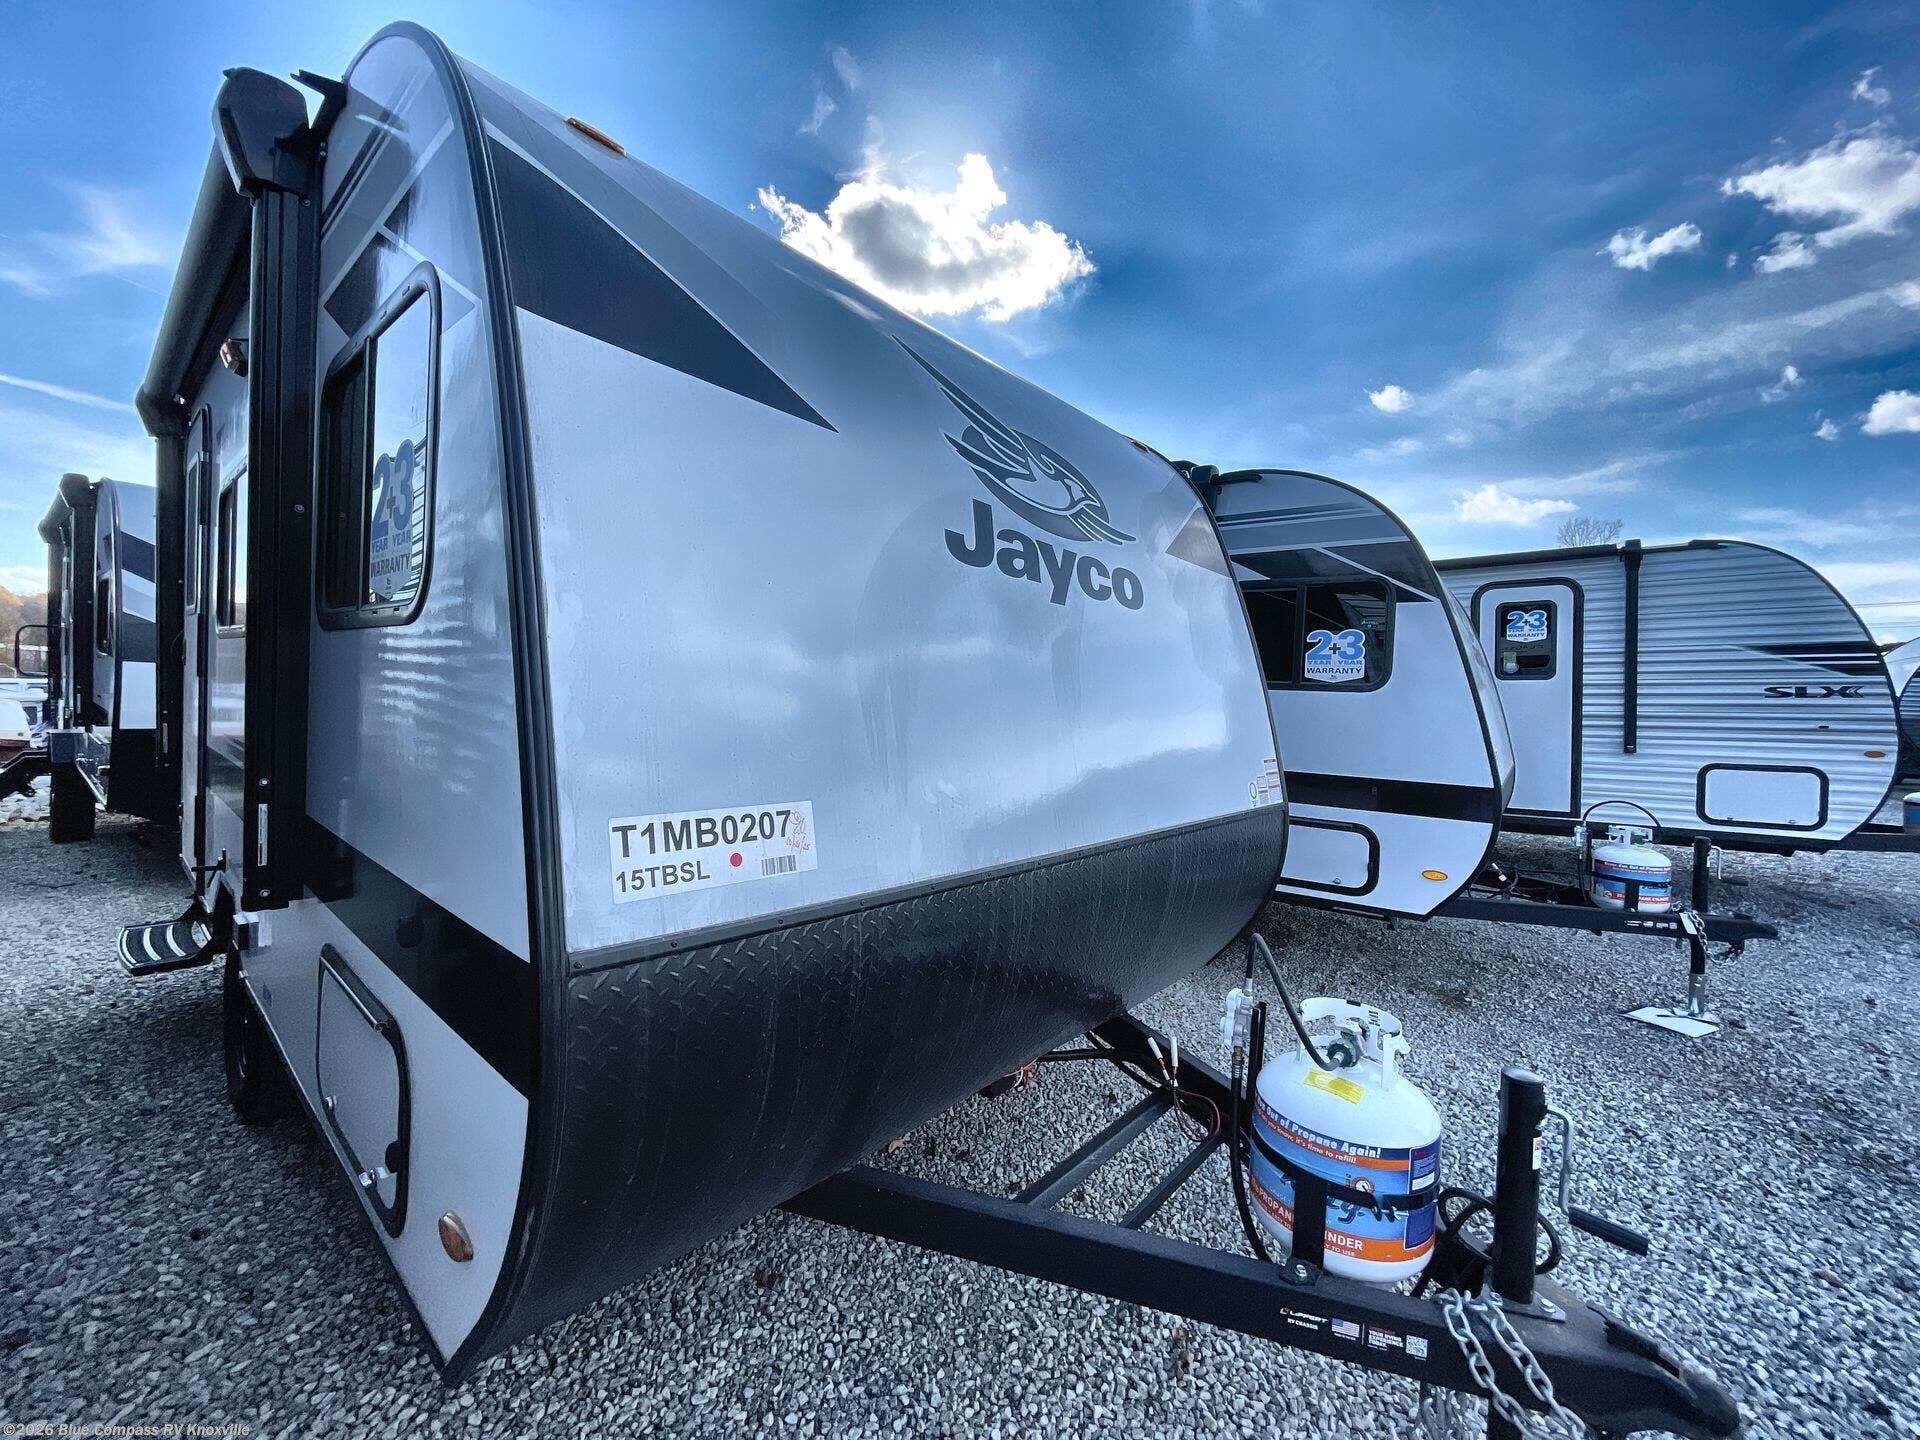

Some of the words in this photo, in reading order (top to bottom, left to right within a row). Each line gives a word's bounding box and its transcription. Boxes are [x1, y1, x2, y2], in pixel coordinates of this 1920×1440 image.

[392, 530, 411, 545] YEAR
[371, 553, 410, 577] WARRANTY
[944, 499, 1144, 610] Jayco
[1508, 611, 1546, 629] 2+3
[1307, 630, 1365, 660] 2+3
[1764, 686, 1864, 698] SLX
[612, 809, 791, 858] T1MB0207
[616, 861, 710, 893] 15TBSL
[1266, 1105, 1279, 1121] Out
[1280, 1117, 1289, 1129] of
[1292, 1123, 1337, 1149] Propane
[1341, 1142, 1382, 1159] Again!
[1295, 1137, 1306, 1148] it's
[1307, 1144, 1323, 1155] time
[1335, 1152, 1357, 1164] refill!
[1259, 1187, 1294, 1221] PROPAN
[1324, 1230, 1363, 1251] INDER
